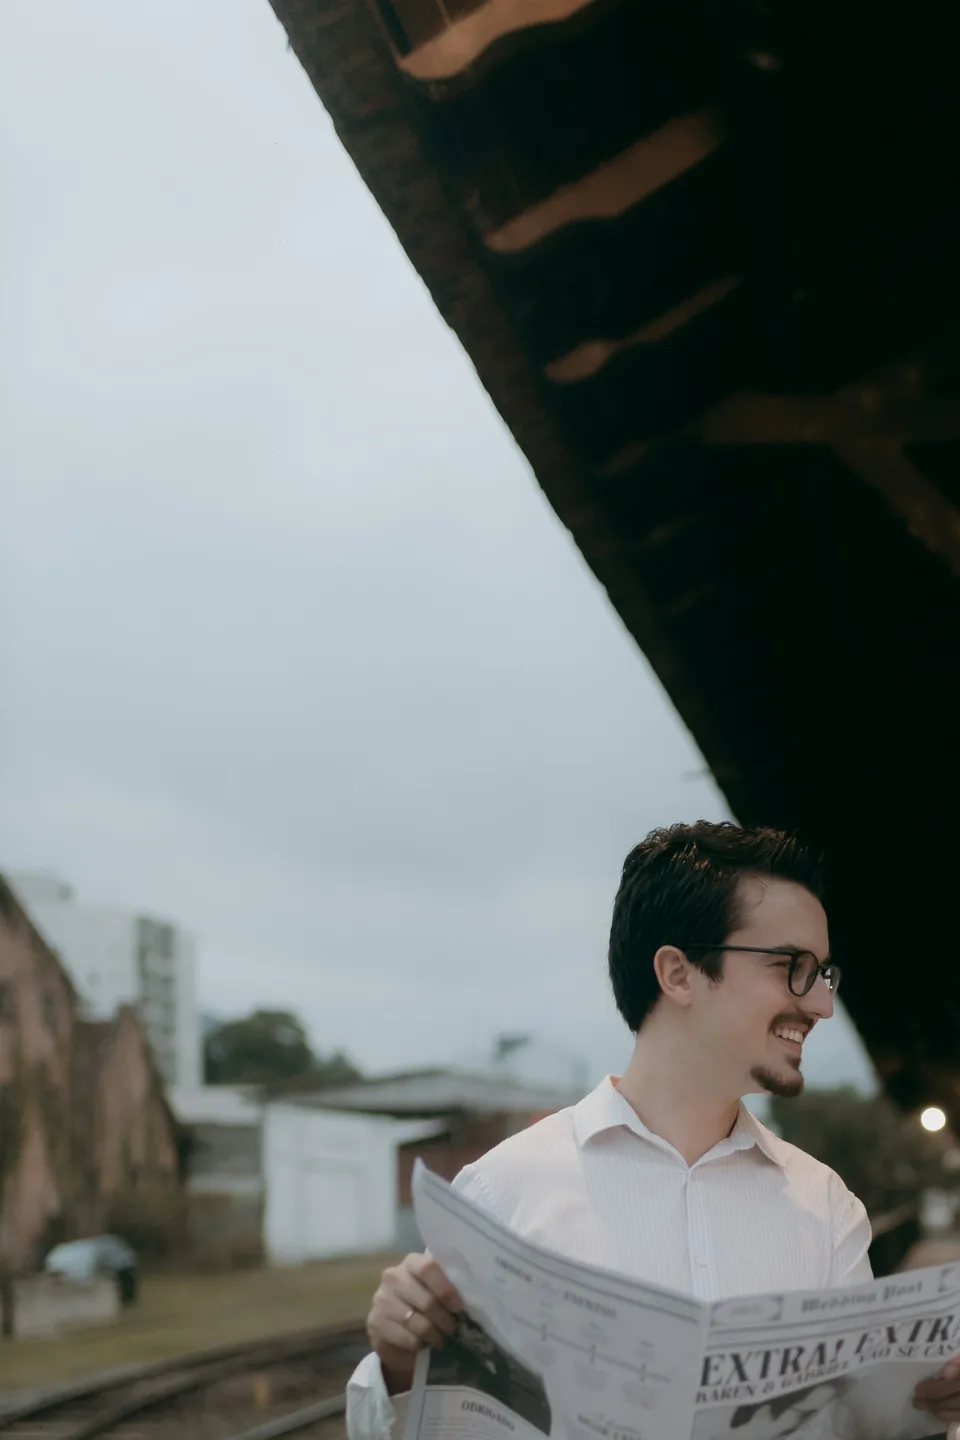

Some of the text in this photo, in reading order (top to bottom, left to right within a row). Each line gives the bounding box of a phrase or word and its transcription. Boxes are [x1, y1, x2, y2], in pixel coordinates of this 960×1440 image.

[883, 1280, 923, 1301] Post
[701, 1339, 844, 1387] EXTRA!
[695, 1385, 756, 1404] KAREN
[461, 1401, 515, 1431] OBRIGADO
